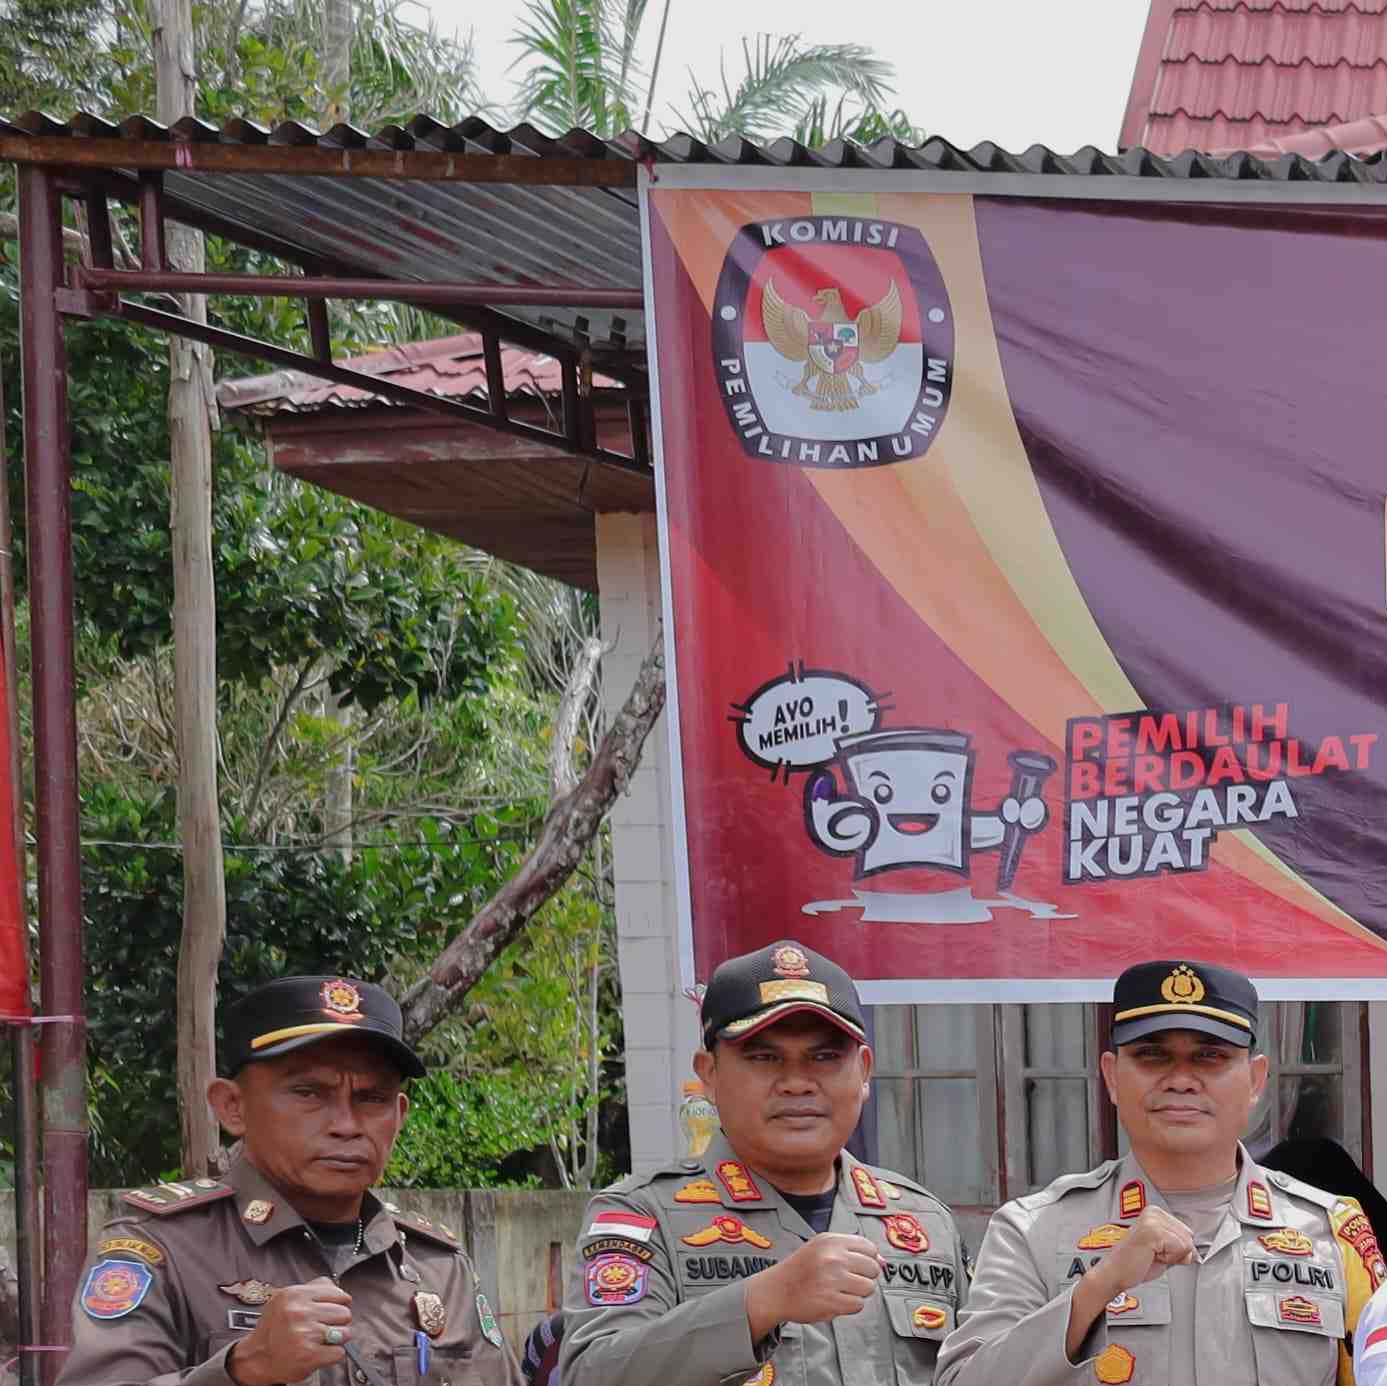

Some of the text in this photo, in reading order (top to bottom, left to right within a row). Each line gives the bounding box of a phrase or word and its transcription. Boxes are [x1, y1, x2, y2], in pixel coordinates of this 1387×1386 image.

[761, 219, 899, 248] KOMISI
[720, 357, 948, 464] PEMILIHAN UMUM
[774, 696, 815, 727] AYO
[1071, 703, 1290, 761] PEMILIH
[1070, 733, 1378, 800] BERDAULAT
[1069, 780, 1299, 841] NEGARA
[1069, 827, 1212, 880] KUAT
[1251, 1260, 1335, 1289] POLRI
